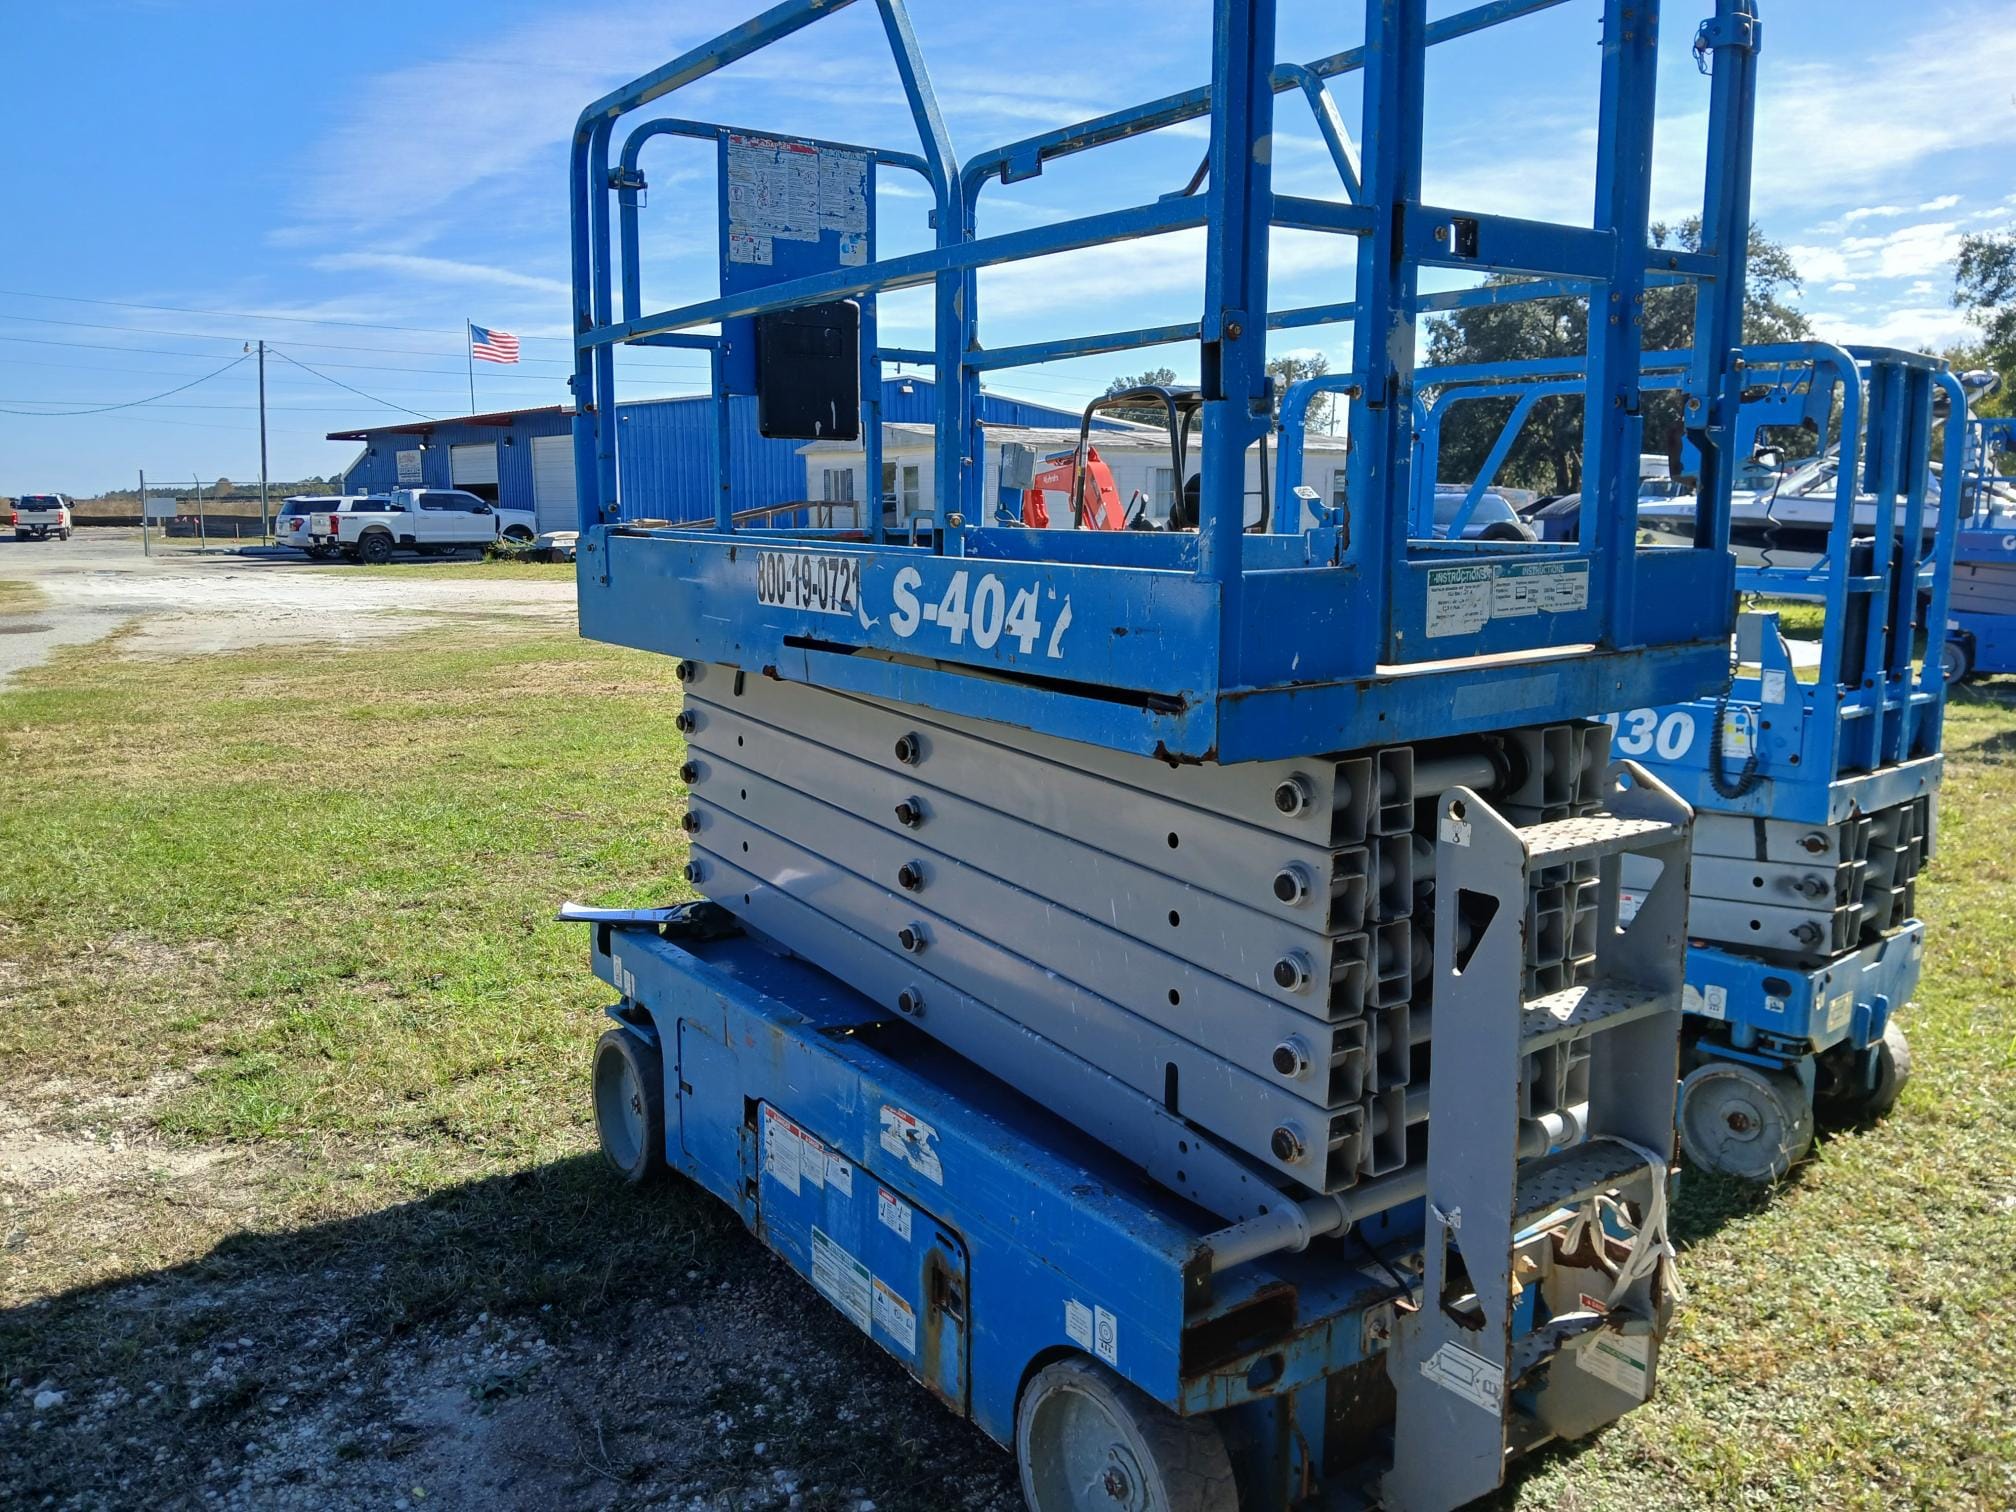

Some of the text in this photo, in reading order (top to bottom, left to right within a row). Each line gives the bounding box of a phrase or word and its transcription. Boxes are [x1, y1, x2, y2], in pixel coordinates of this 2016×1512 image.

[1434, 567, 1486, 584] INSTRUCTIONS
[1521, 563, 1565, 576] INSTRUCTIONS
[757, 552, 860, 612] 800-19-0721
